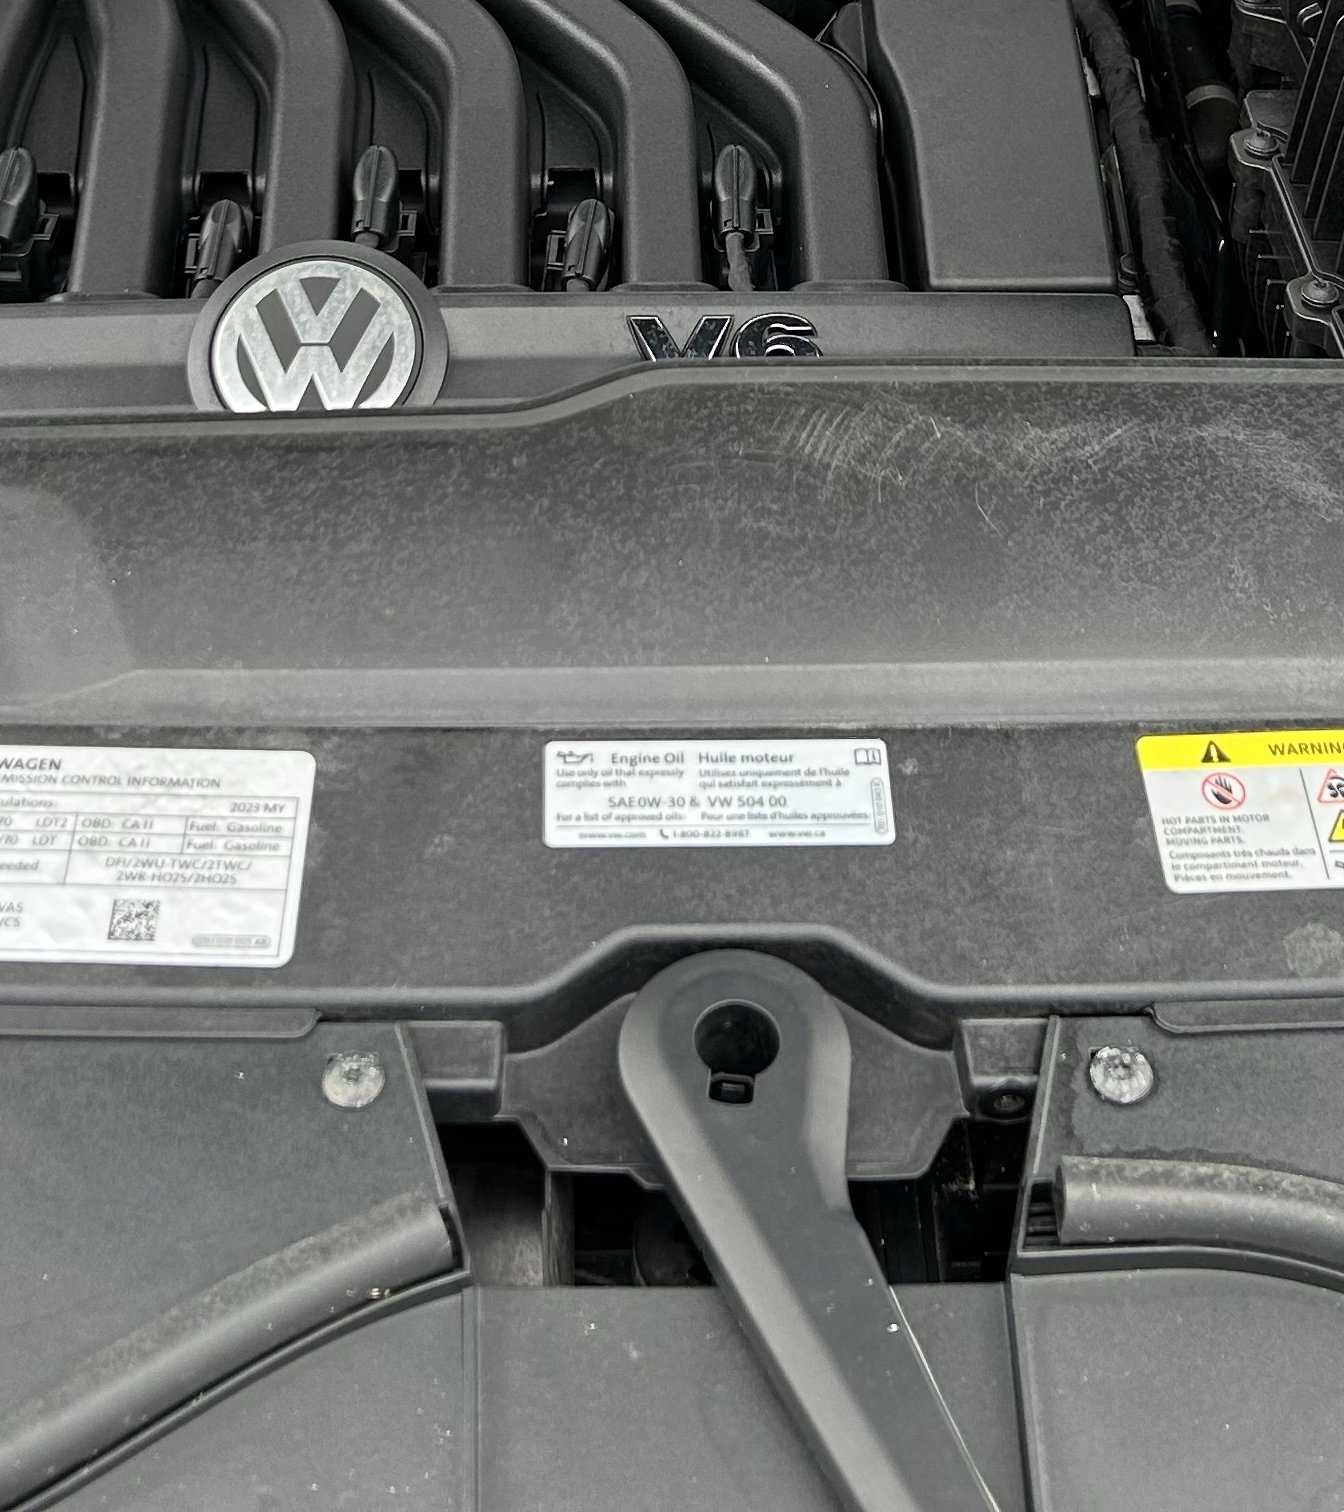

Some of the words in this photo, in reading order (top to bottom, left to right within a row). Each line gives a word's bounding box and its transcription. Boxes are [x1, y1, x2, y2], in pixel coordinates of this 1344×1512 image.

[218, 260, 412, 413] VW
[626, 312, 824, 360] V6
[612, 752, 660, 767] Engine
[664, 752, 685, 764] Oil
[699, 752, 737, 764] Huile
[741, 753, 794, 764] moteur
[557, 769, 576, 777] Use
[577, 769, 599, 779] only
[601, 769, 613, 777] oil
[615, 769, 636, 777] that
[638, 769, 685, 779] expressly
[699, 768, 737, 777] Utilisez
[739, 768, 801, 779] uniquement
[804, 768, 817, 777] de
[819, 767, 850, 777] l'huile
[62, 774, 123, 786] CONTROL
[127, 776, 221, 789] INFORMATION
[557, 780, 601, 790] complies
[604, 780, 627, 788] with
[699, 779, 716, 790] qui
[718, 779, 759, 788] satisfait
[689, 797, 700, 808] &
[708, 796, 733, 807] VW
[738, 796, 764, 807] 504
[768, 796, 787, 807] 00
[230, 802, 260, 813] 2023
[264, 802, 285, 814] MY
[557, 812, 573, 821] For
[584, 812, 599, 821] list
[602, 812, 613, 821] of
[614, 812, 663, 823] approved
[701, 811, 723, 820] Pour
[726, 812, 745, 821] une
[747, 811, 768, 820] liste
[1162, 816, 1183, 825] HOT
[1186, 815, 1217, 825] PARTS
[1219, 815, 1230, 824] IN
[1233, 814, 1271, 824] MOTOR
[227, 822, 283, 834] Gasoline
[224, 840, 280, 851] Gasoline
[1166, 836, 1209, 846] MOVING
[1169, 850, 1232, 861] Composants
[1256, 847, 1291, 857] chauds
[1292, 847, 1317, 856] dans
[1172, 862, 1182, 871] le
[1184, 860, 1258, 871] compartiment
[1175, 873, 1208, 882] Pièces
